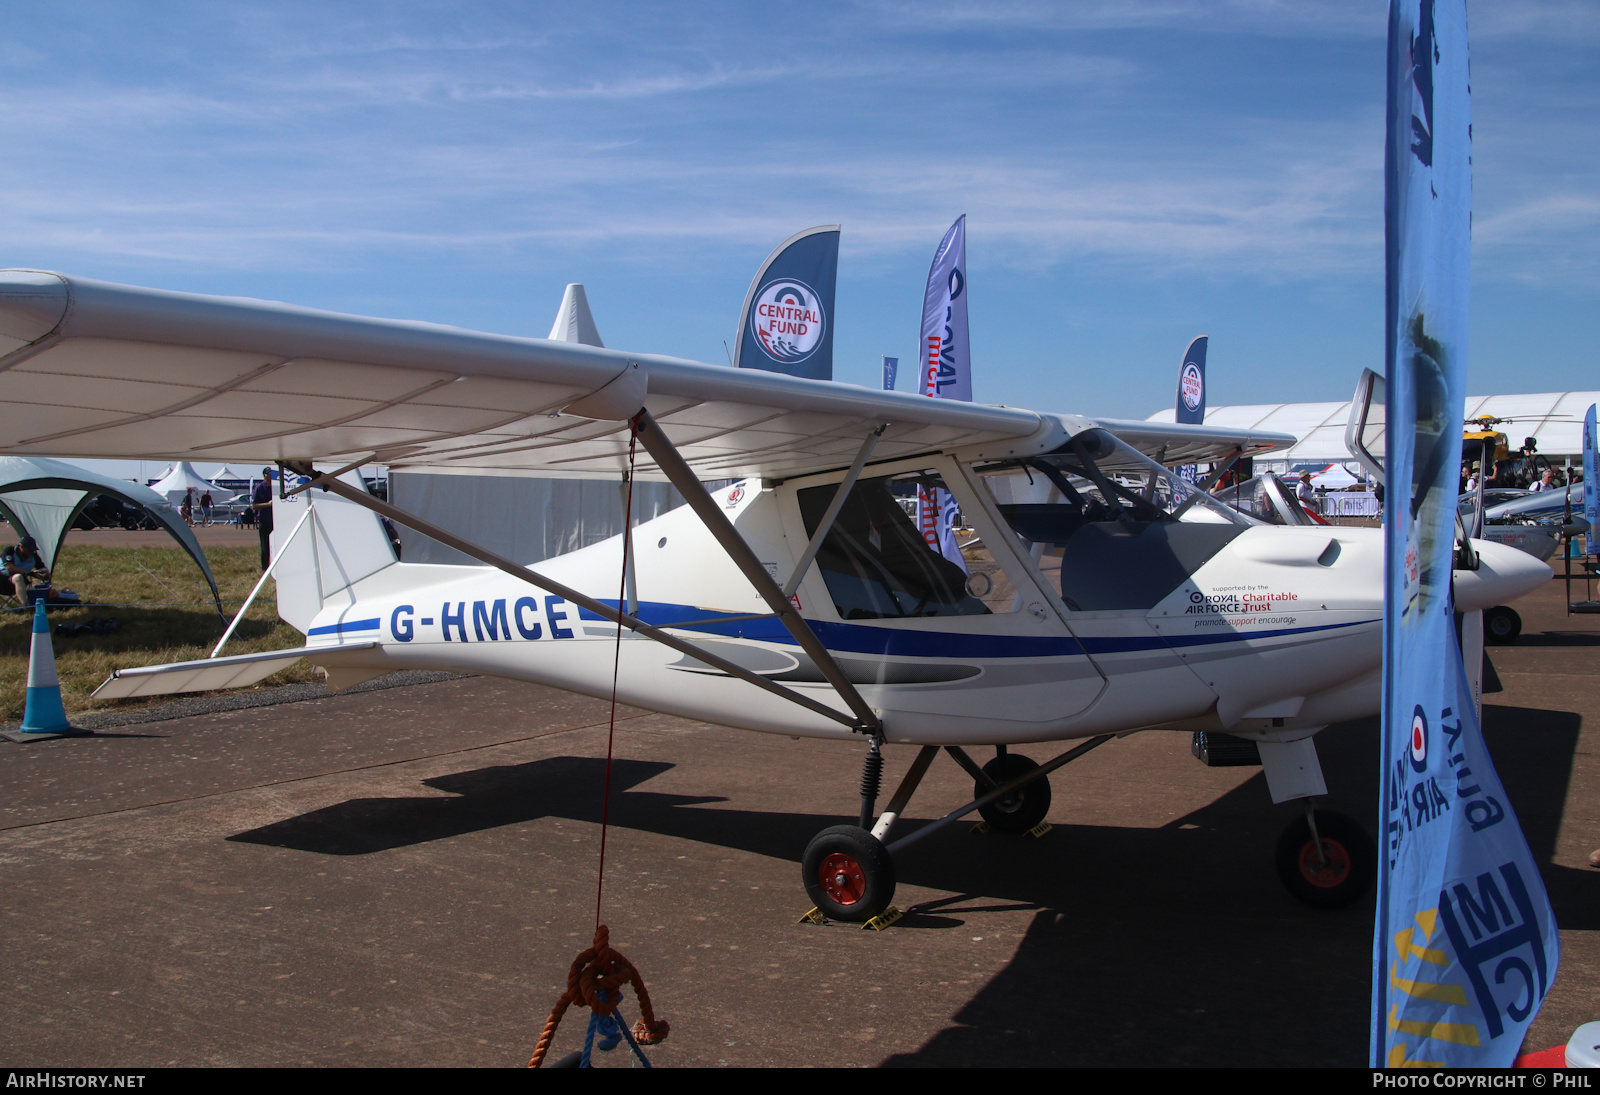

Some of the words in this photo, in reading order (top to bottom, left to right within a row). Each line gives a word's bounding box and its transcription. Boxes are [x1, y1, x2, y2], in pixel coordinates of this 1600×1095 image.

[758, 304, 819, 324] CENTRAL
[769, 319, 808, 336] FUND
[1183, 376, 1201, 390] CENTRAL
[1186, 385, 1199, 396] FUND
[1205, 594, 1240, 604] ROYAL
[1242, 592, 1298, 602] Charitable
[1185, 605, 1204, 614] AIR
[1205, 603, 1240, 613] FORCE
[1243, 602, 1271, 612] Trust
[390, 595, 575, 642] G-HMCE
[1195, 619, 1226, 628] promote
[1228, 617, 1257, 626] support
[1258, 617, 1297, 626] encourage
